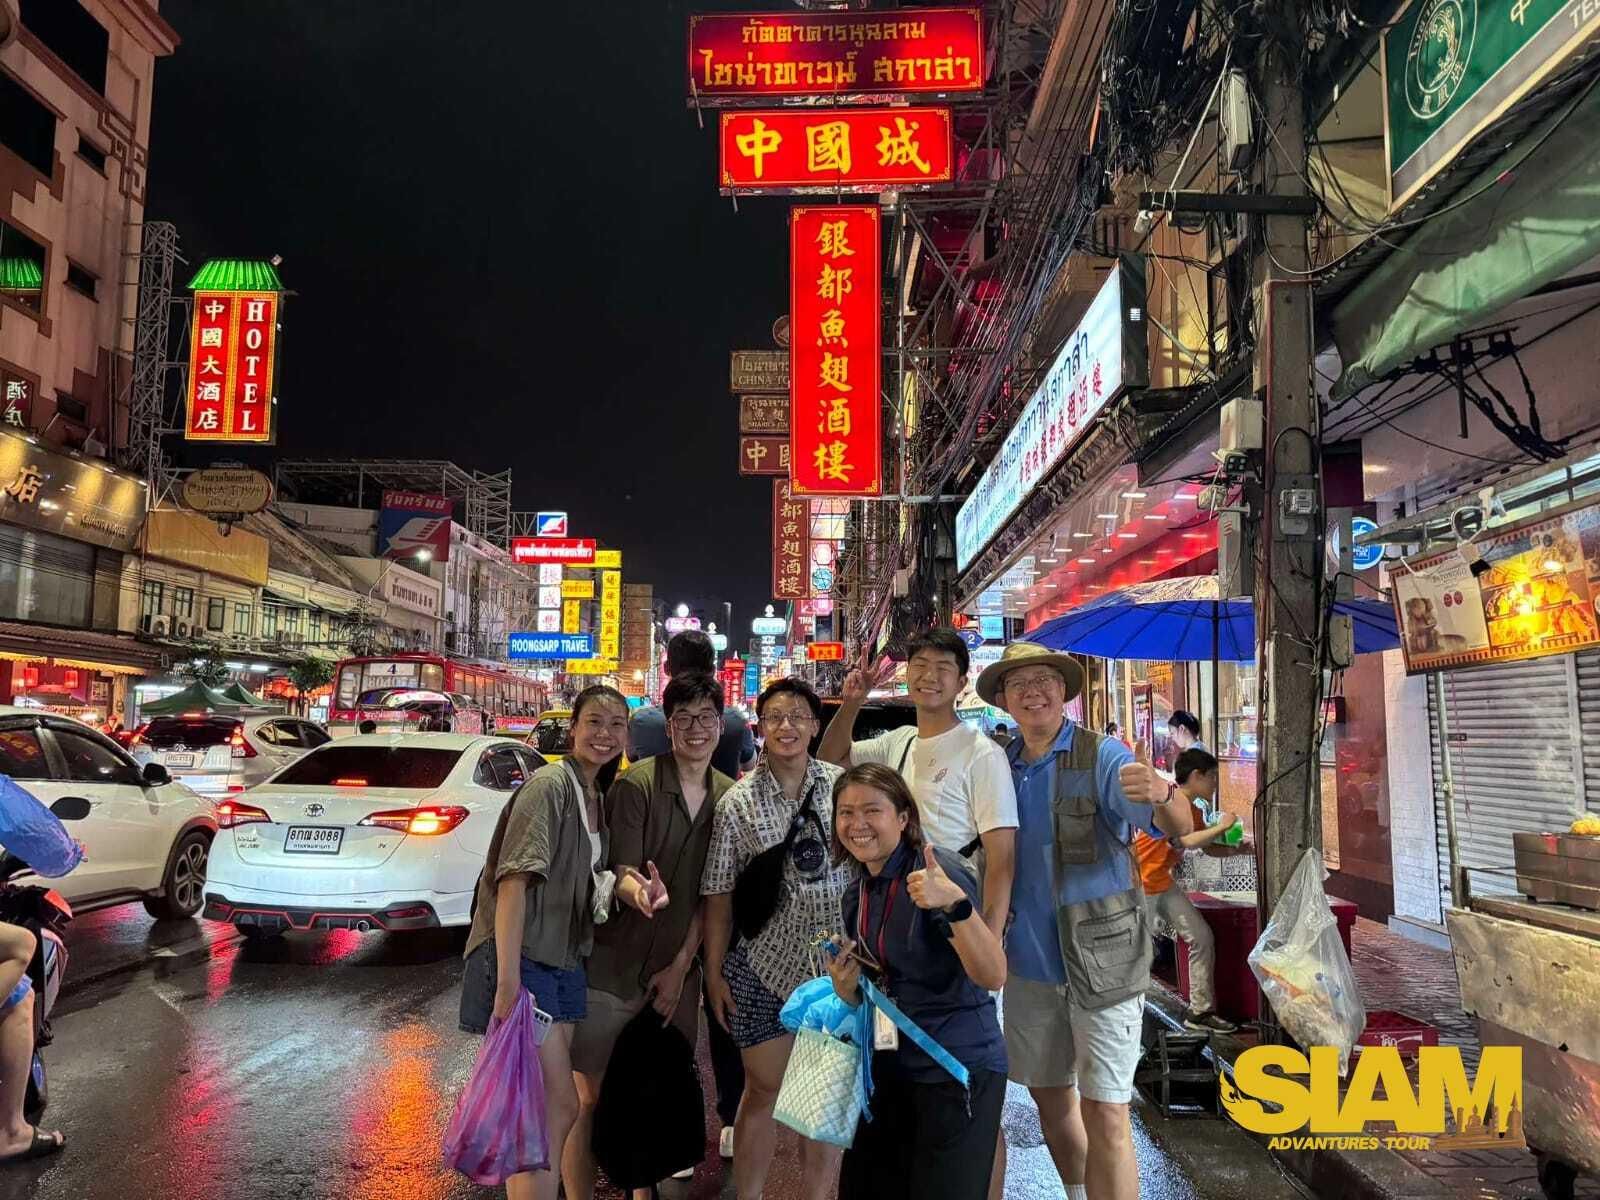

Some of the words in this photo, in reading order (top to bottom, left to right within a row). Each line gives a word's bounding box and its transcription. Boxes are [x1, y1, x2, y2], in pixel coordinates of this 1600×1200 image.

[699, 48, 858, 86] ไชน่าทาวน์
[873, 46, 972, 83] สกาล่า
[735, 117, 930, 178] 中國城
[194, 300, 225, 430] 中國大酒店
[241, 301, 266, 431] HOTEL
[813, 220, 856, 483] 銀都魚翅酒樓
[738, 375, 772, 385] CHINA
[5, 465, 43, 503] 店
[511, 640, 560, 652] ROONGSARP
[561, 639, 590, 652] TRAVEL
[968, 634, 976, 645] 2
[387, 663, 398, 675] 4
[313, 830, 339, 842] 3088
